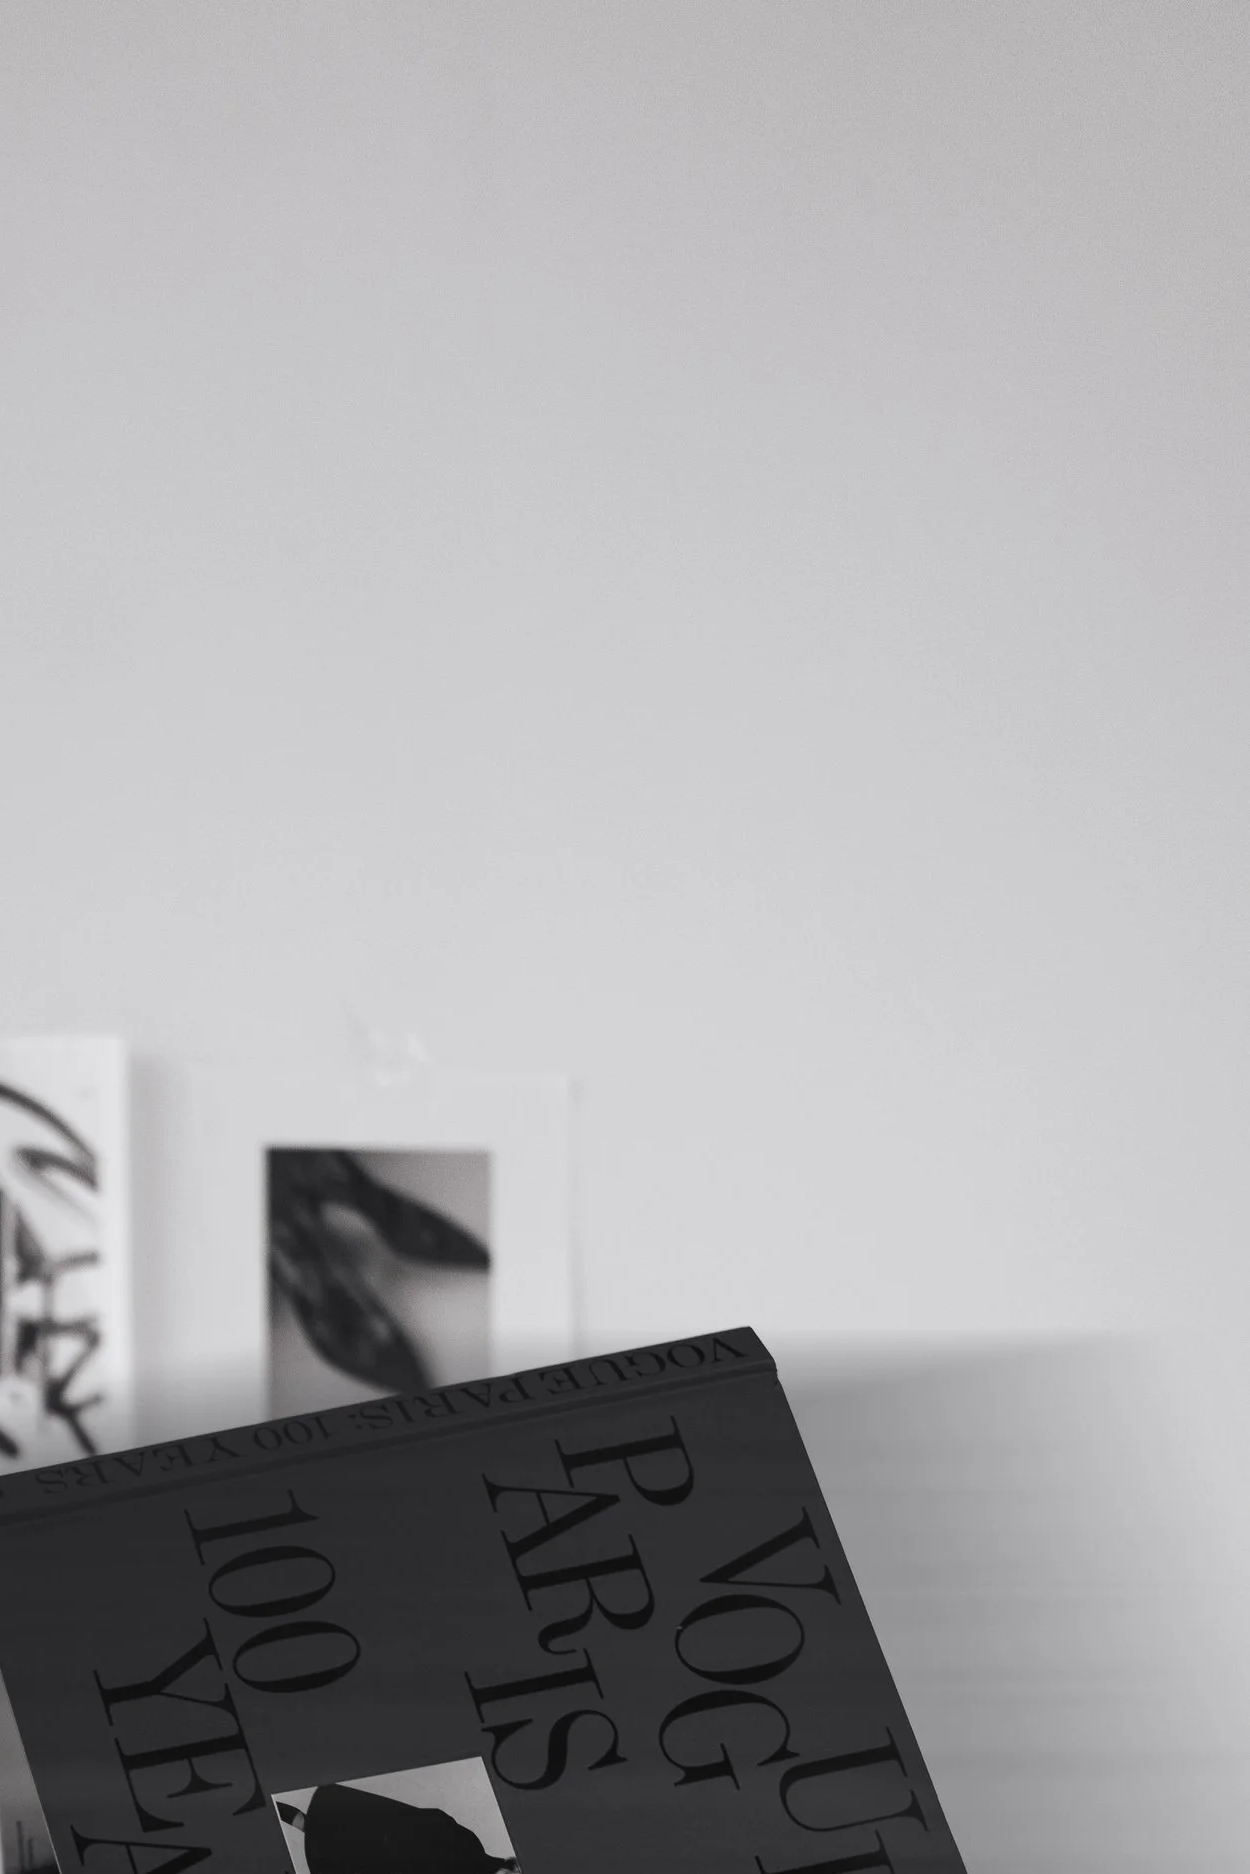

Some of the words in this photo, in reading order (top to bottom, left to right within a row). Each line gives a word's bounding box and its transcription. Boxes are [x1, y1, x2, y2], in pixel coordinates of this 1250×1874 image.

[538, 1336, 750, 1396] VOGUE
[347, 1376, 536, 1430] PARIS:
[252, 1415, 337, 1452] 100
[34, 1436, 249, 1496] YEARS
[183, 1488, 362, 1693] 100
[464, 1416, 694, 1790] PARIS
